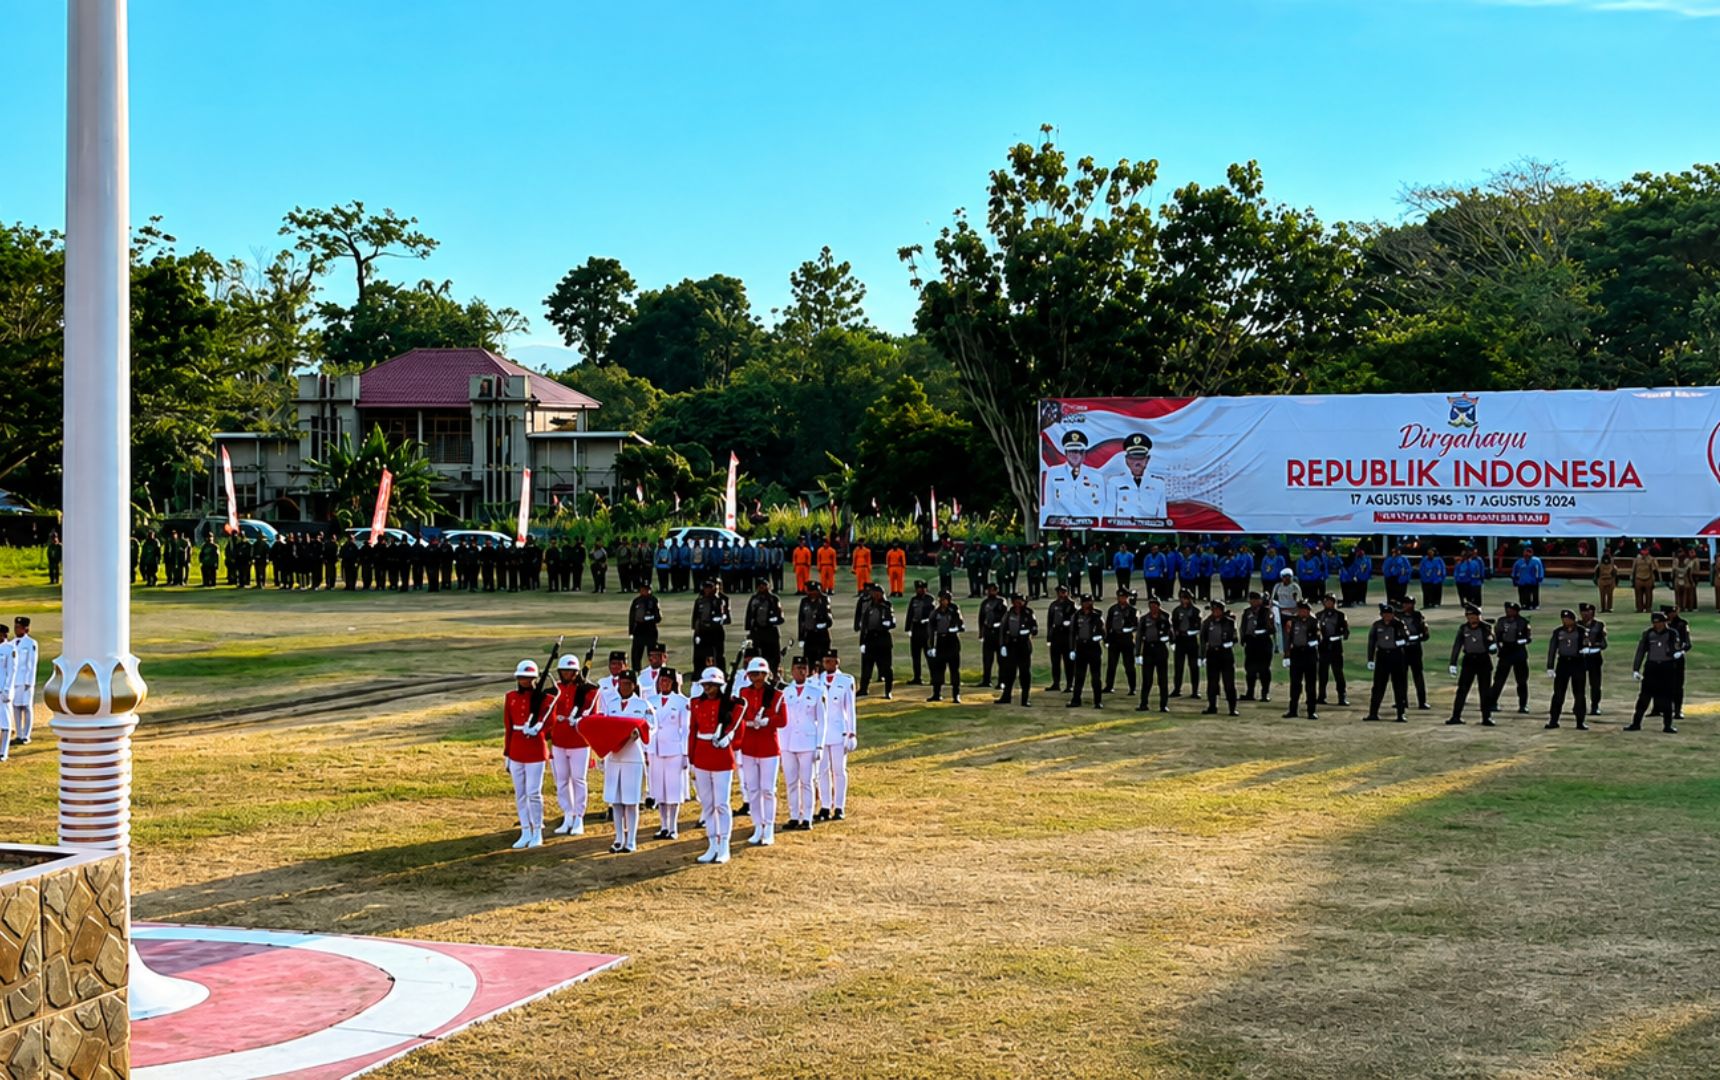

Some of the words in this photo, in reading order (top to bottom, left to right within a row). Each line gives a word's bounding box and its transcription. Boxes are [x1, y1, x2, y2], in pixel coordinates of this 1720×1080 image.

[1398, 423, 1527, 457] Dirgahayu
[1287, 459, 1440, 487] REPUBLIK
[1454, 460, 1643, 488] INDONESIA
[1351, 494, 1361, 505] 17
[1365, 493, 1423, 506] AGUSTUS
[1427, 494, 1453, 506] 1945
[1465, 495, 1476, 506] 17
[1480, 495, 1541, 507] AGUSTUS
[1545, 495, 1576, 507] 2024
